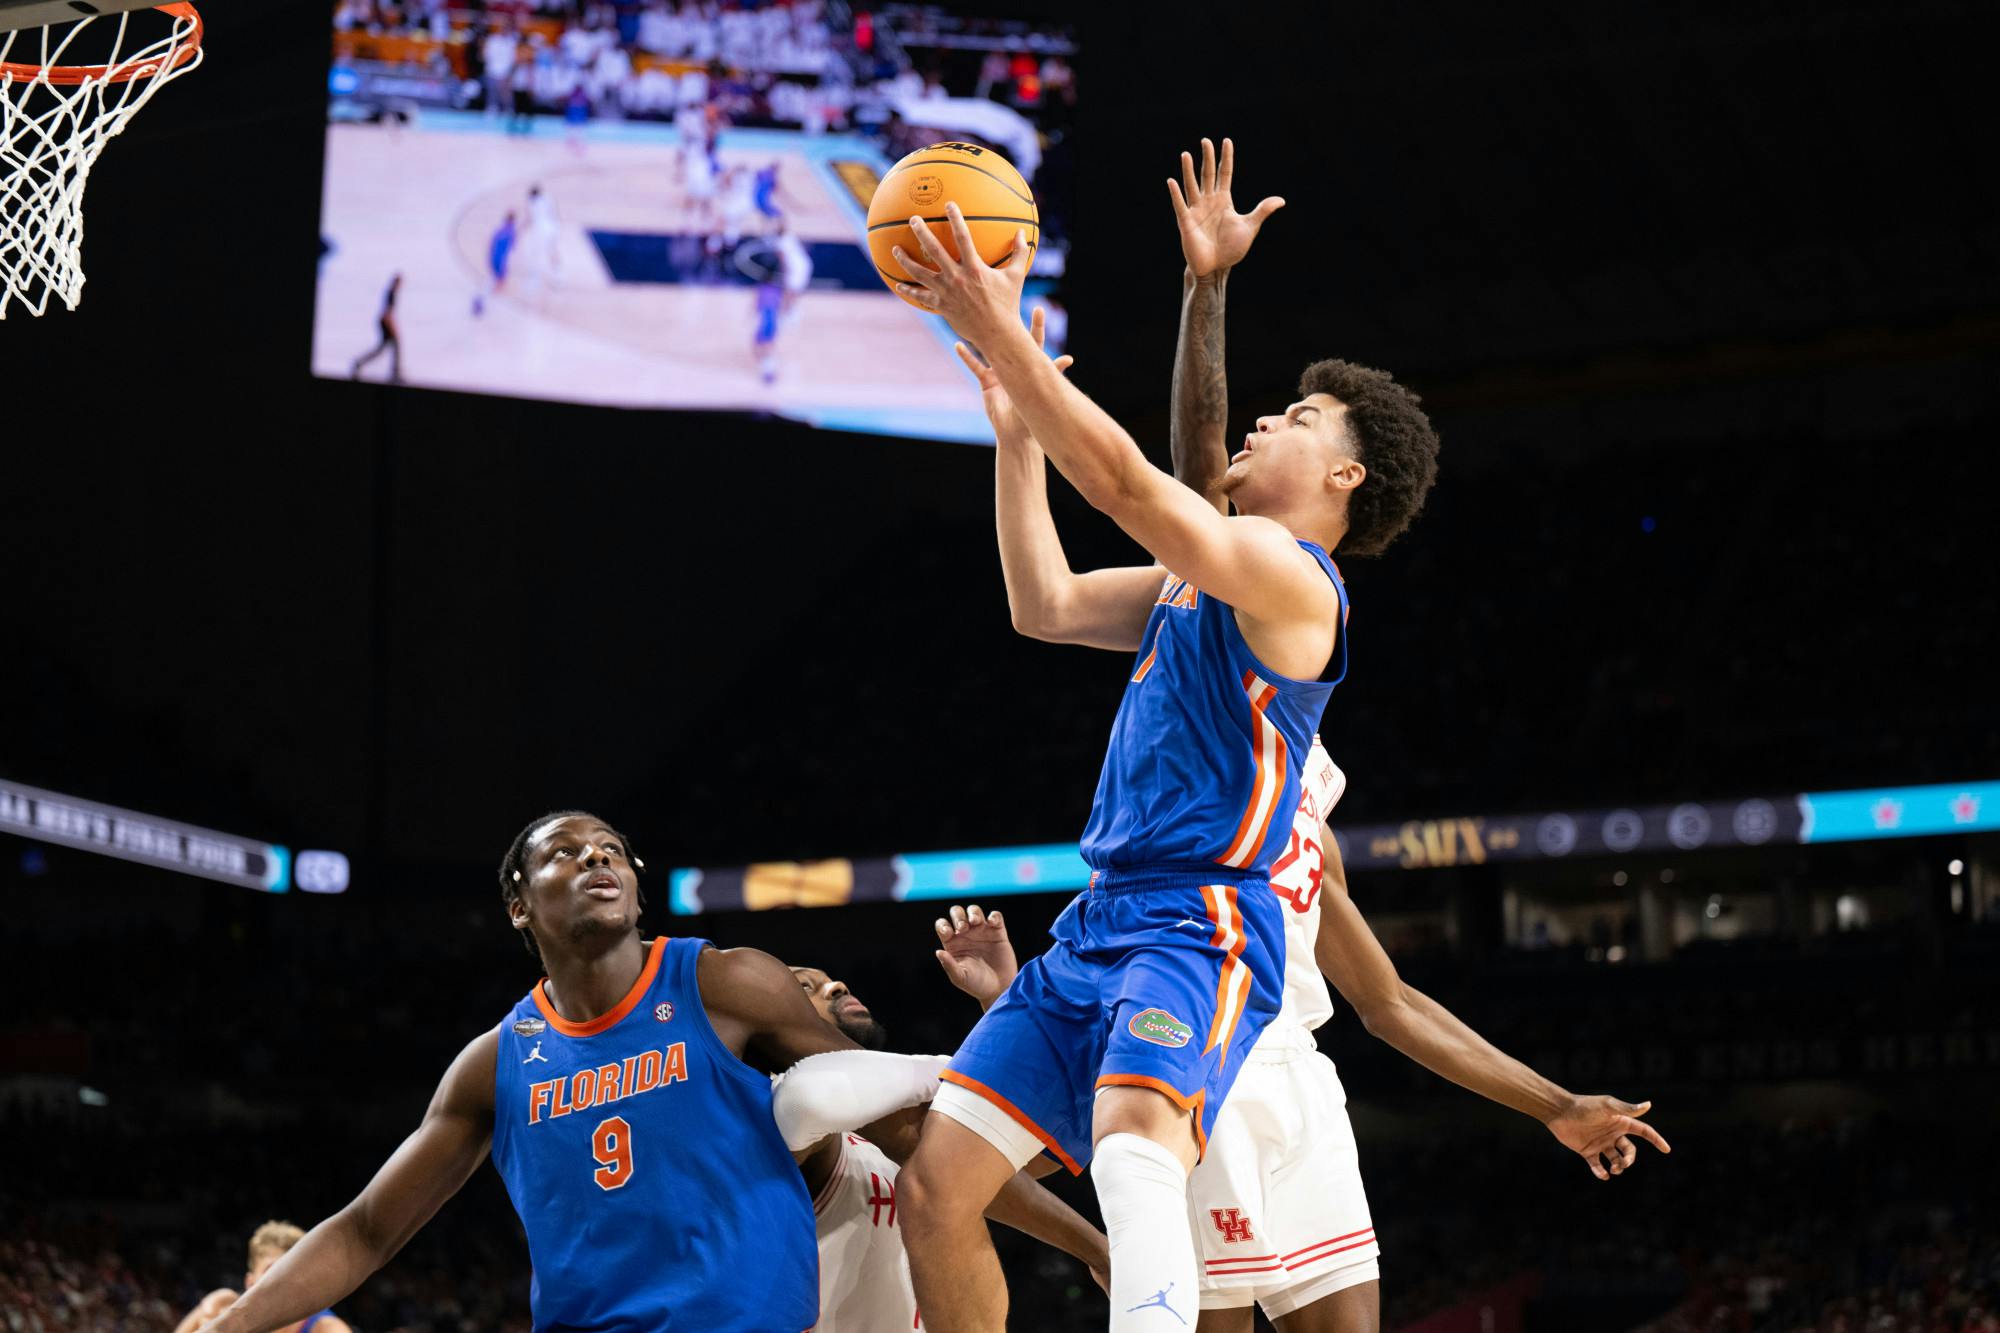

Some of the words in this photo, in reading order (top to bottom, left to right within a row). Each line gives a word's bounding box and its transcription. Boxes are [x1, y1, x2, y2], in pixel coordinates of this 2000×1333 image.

[1269, 828, 1324, 913] 23
[655, 1003, 672, 1020] SEC
[528, 1042, 688, 1125] FLORIDA
[592, 1115, 634, 1191] 9
[1210, 1208, 1253, 1243] UH
